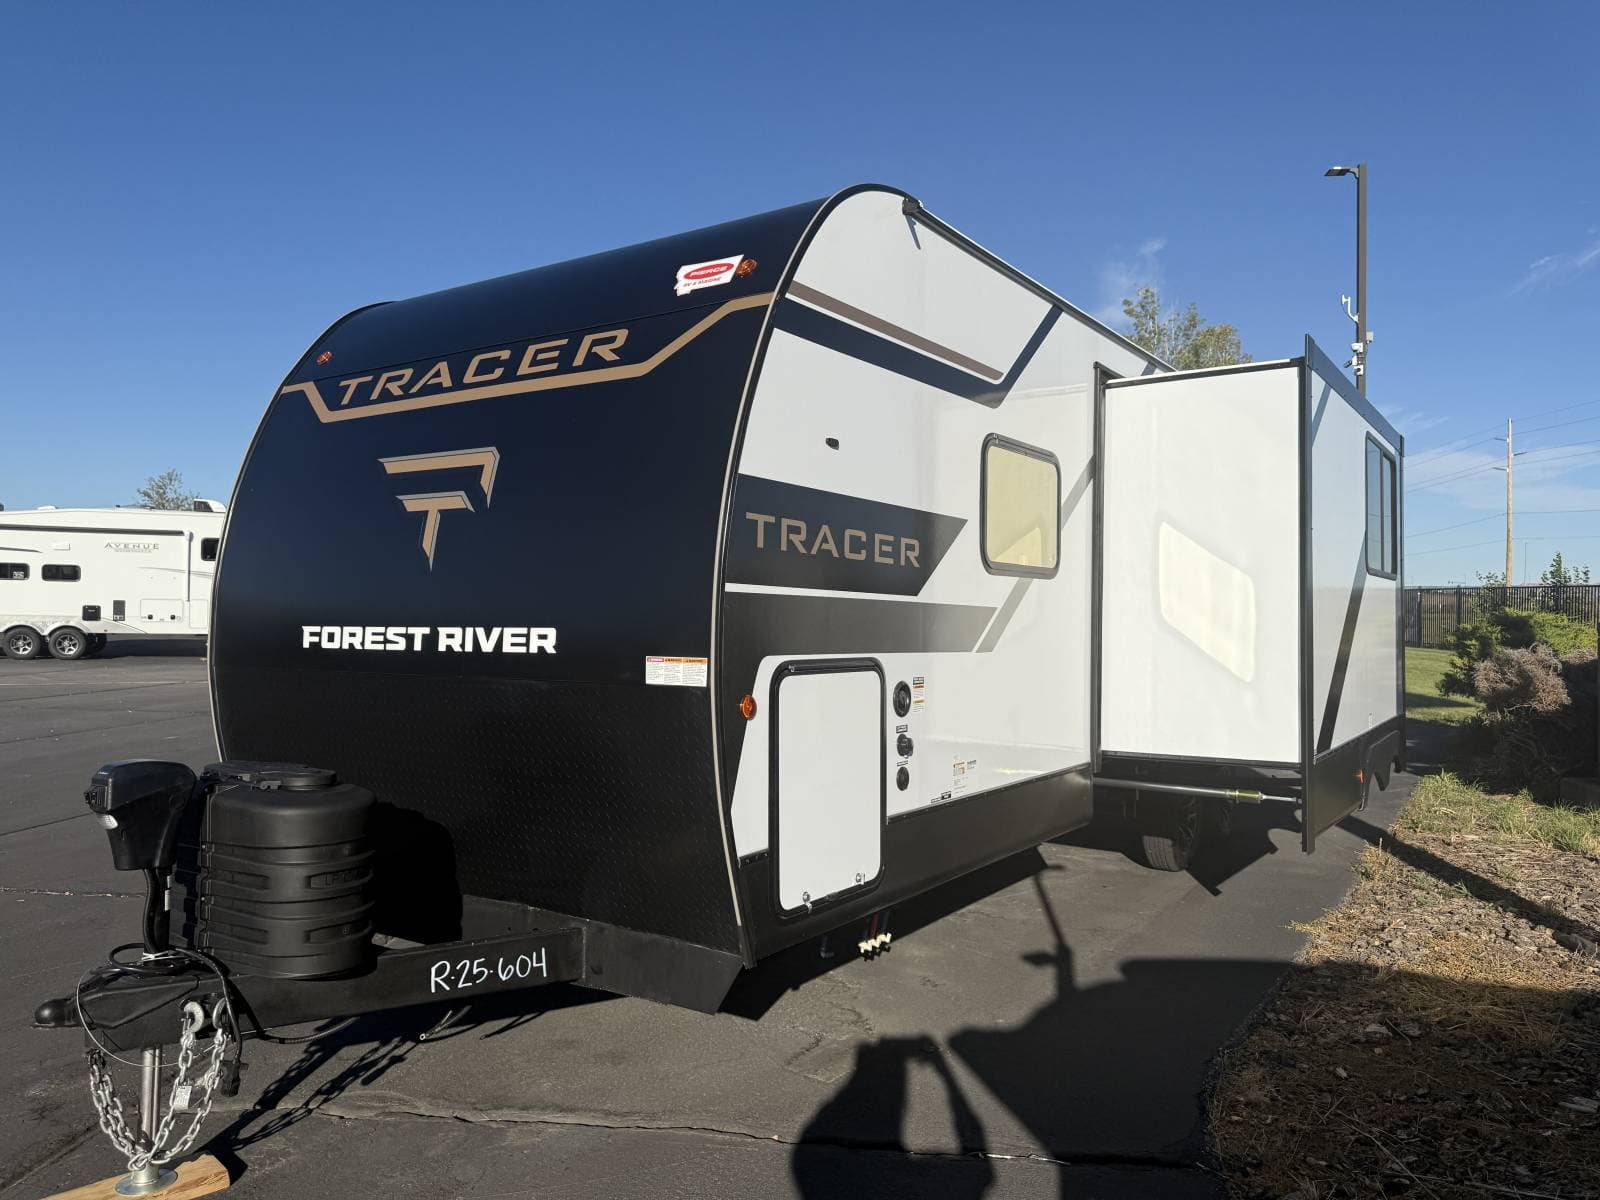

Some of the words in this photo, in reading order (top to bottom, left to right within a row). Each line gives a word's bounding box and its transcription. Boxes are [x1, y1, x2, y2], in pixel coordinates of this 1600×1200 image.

[339, 328, 629, 406] TRACER
[745, 511, 920, 568] TRACER
[302, 625, 430, 649] FOREST
[437, 627, 557, 654] RIVER
